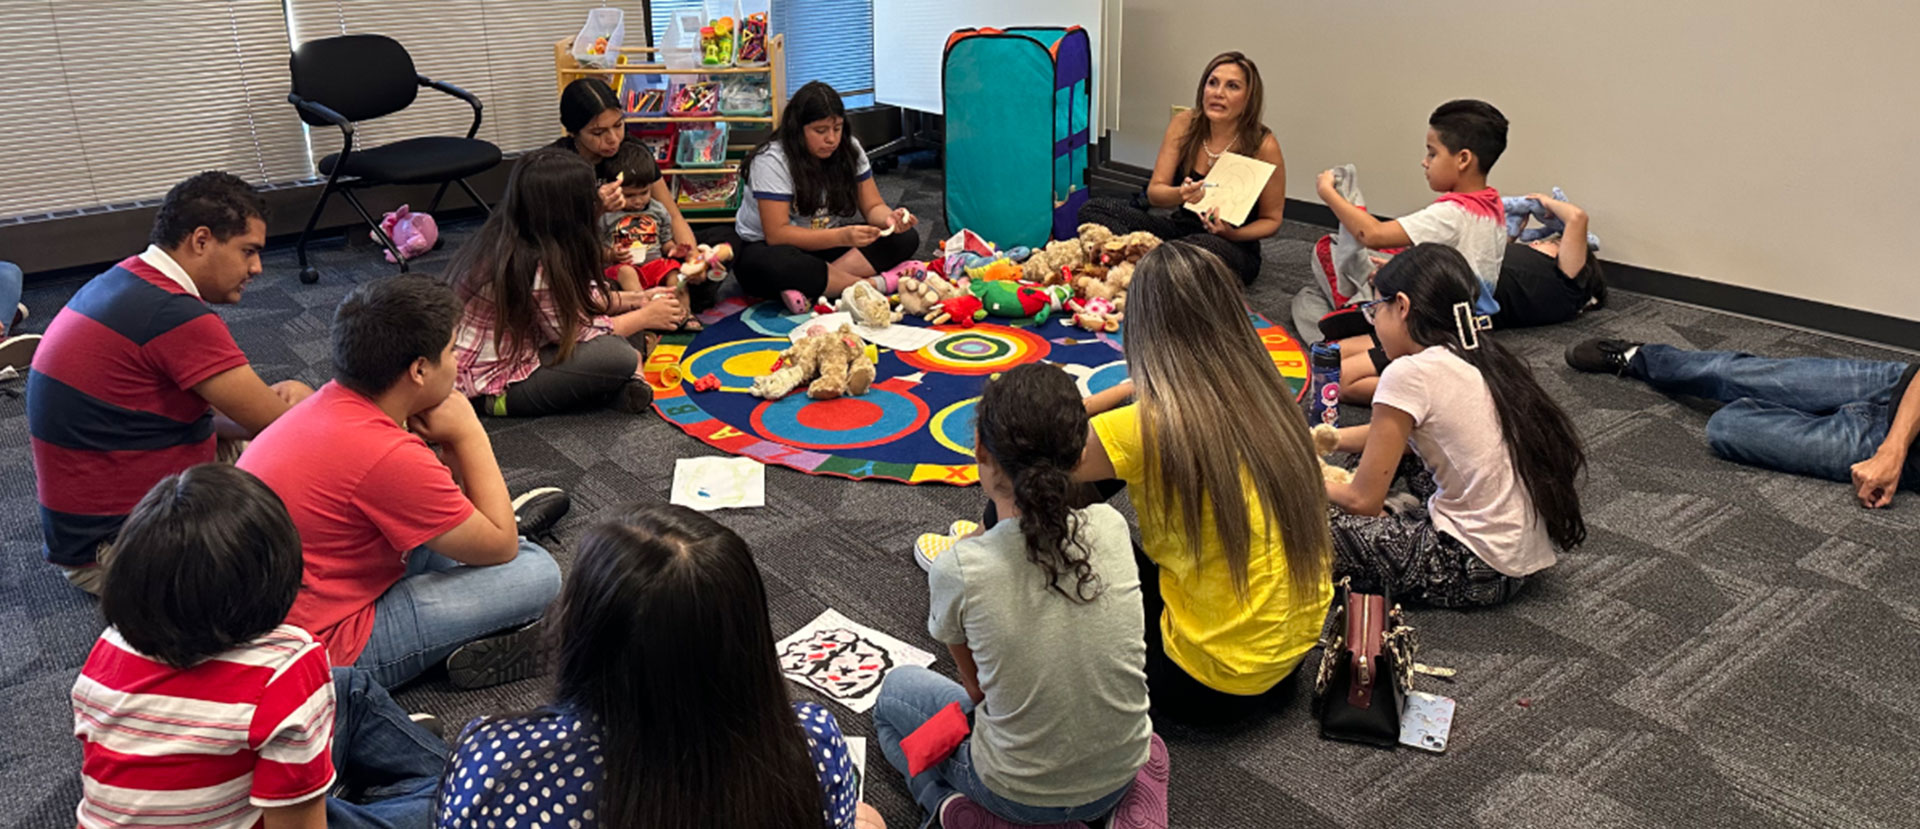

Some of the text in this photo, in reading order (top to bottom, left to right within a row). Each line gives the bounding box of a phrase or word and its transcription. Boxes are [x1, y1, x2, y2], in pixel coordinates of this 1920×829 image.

[650, 353, 679, 364] D
[1273, 360, 1303, 368] R
[666, 404, 699, 416] B
[708, 425, 745, 441] A
[764, 444, 804, 462] Z
[848, 460, 876, 476] Y
[944, 465, 970, 481] X
